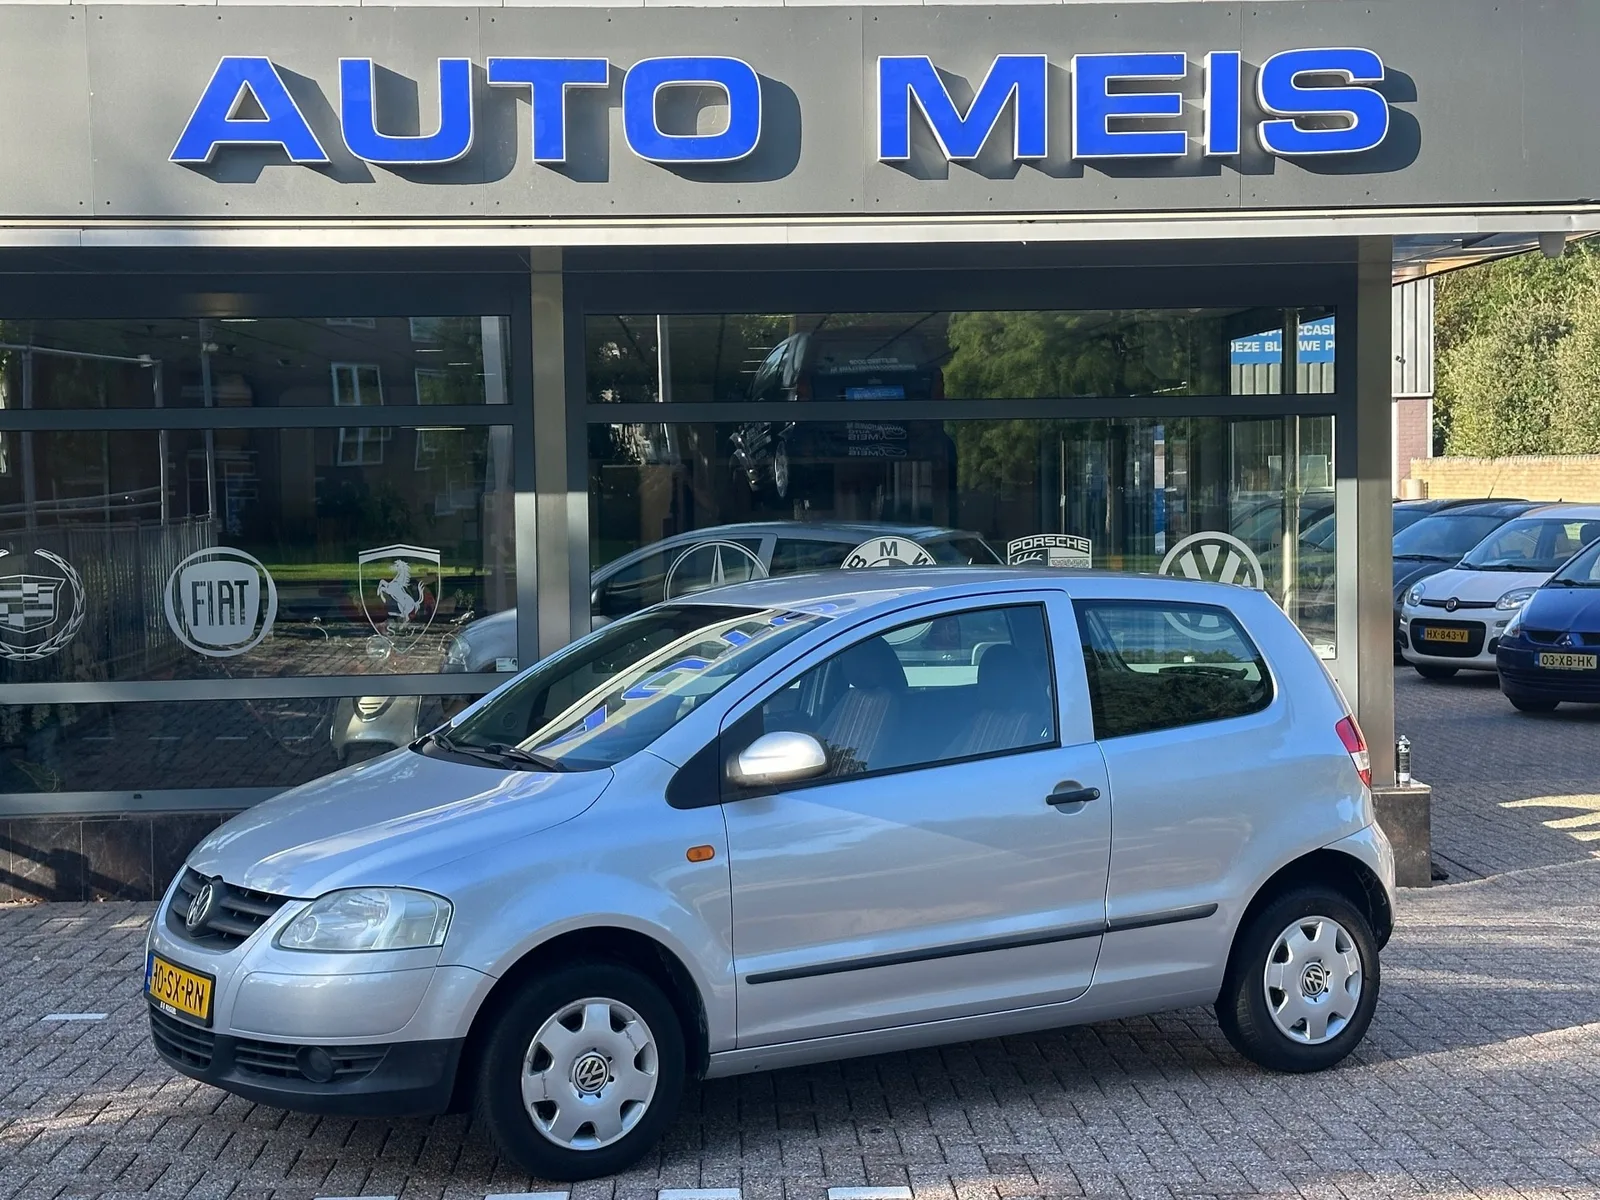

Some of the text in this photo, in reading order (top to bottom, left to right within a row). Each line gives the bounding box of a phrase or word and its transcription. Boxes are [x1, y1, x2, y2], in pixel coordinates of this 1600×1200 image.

[170, 47, 1389, 165] AUTO MEIS
[1010, 536, 1089, 554] PORSCHE
[191, 580, 250, 627] FIAT
[1426, 629, 1466, 641] HX-843-V
[1541, 654, 1594, 668] 03-XB-HK
